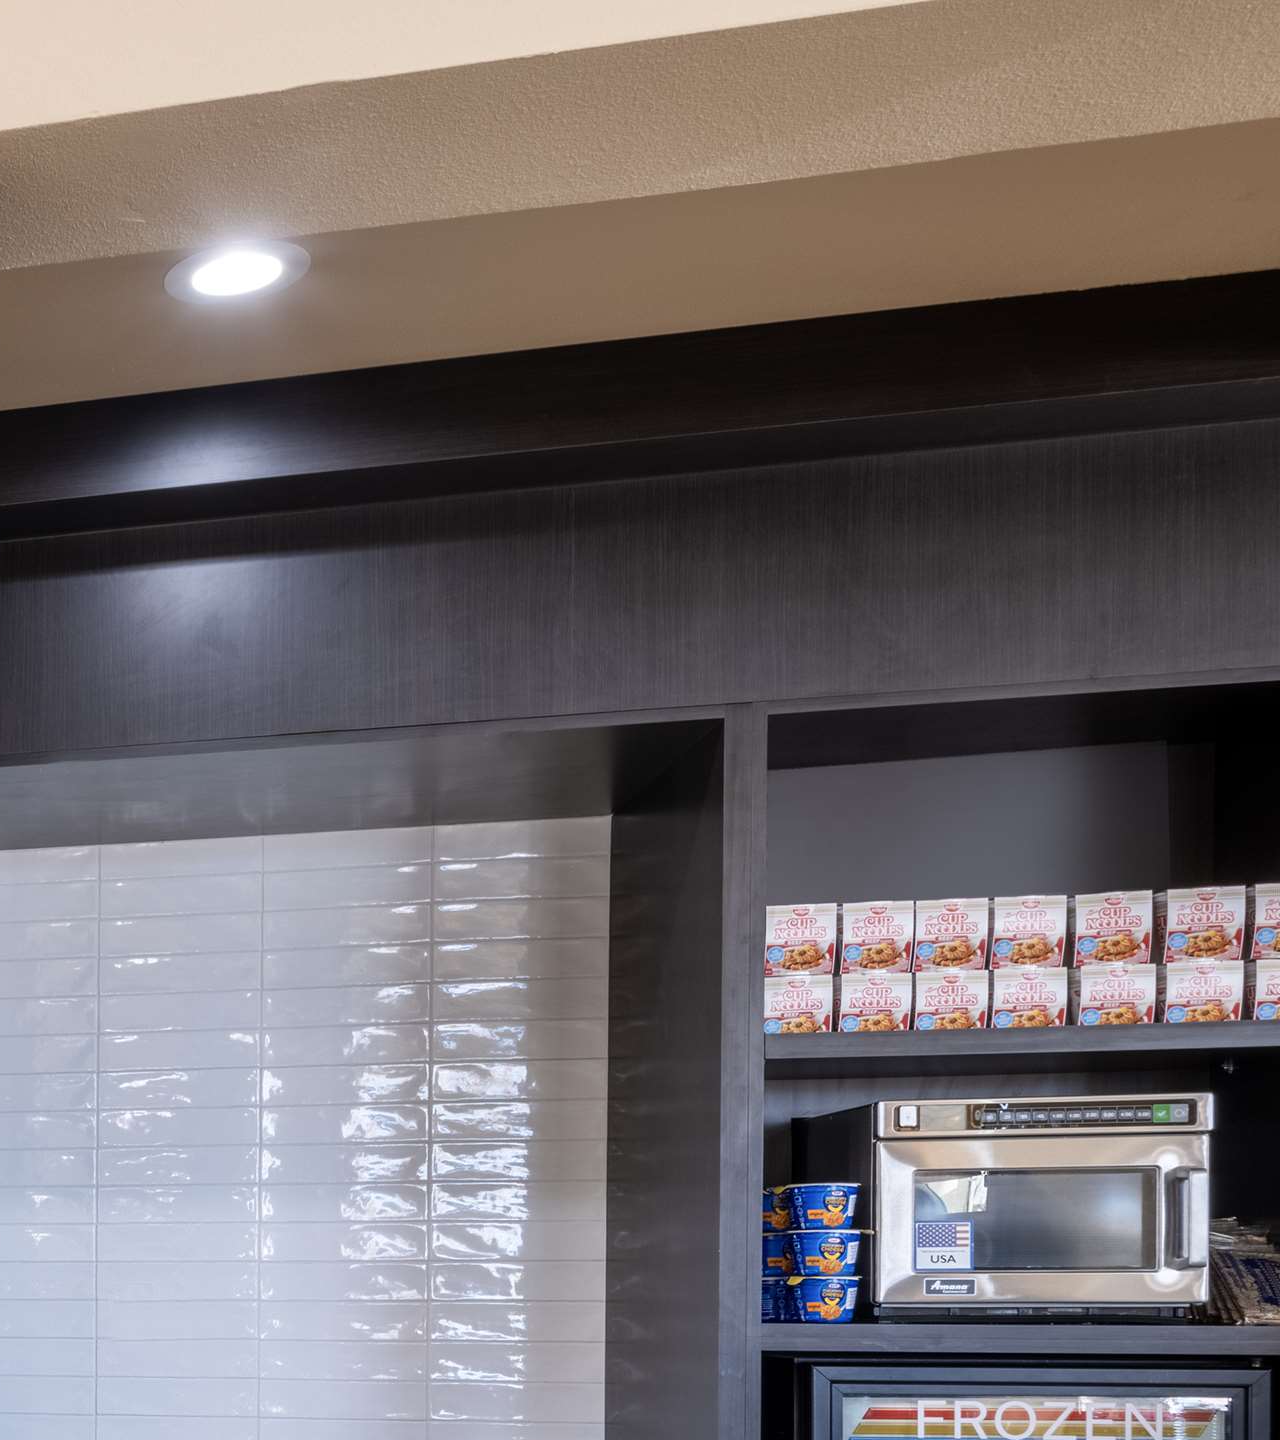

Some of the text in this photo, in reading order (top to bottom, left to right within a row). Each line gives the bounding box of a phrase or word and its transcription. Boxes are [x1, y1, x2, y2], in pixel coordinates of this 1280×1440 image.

[1099, 906, 1132, 918] CUP
[1191, 902, 1223, 914] CUP
[864, 915, 893, 927] CUP
[938, 912, 968, 924] CUP
[1016, 910, 1046, 922] CUP
[1176, 912, 1235, 925] NOODLES
[786, 917, 816, 928] CUP
[1002, 920, 1056, 932] NOODLES
[1085, 916, 1142, 930] NOODLES
[775, 927, 827, 939] NOODLES
[852, 926, 905, 938] NOODLES
[924, 923, 978, 935] NOODLES
[862, 986, 892, 998] CUP
[938, 984, 968, 996] CUP
[1016, 981, 1046, 993] CUP
[783, 989, 813, 1000] CUP
[924, 994, 978, 1007] NOODLES
[1002, 991, 1056, 1004] NOODLES
[770, 999, 822, 1011] NOODLES
[849, 996, 901, 1008] NOODLES
[930, 1255, 957, 1264] USA
